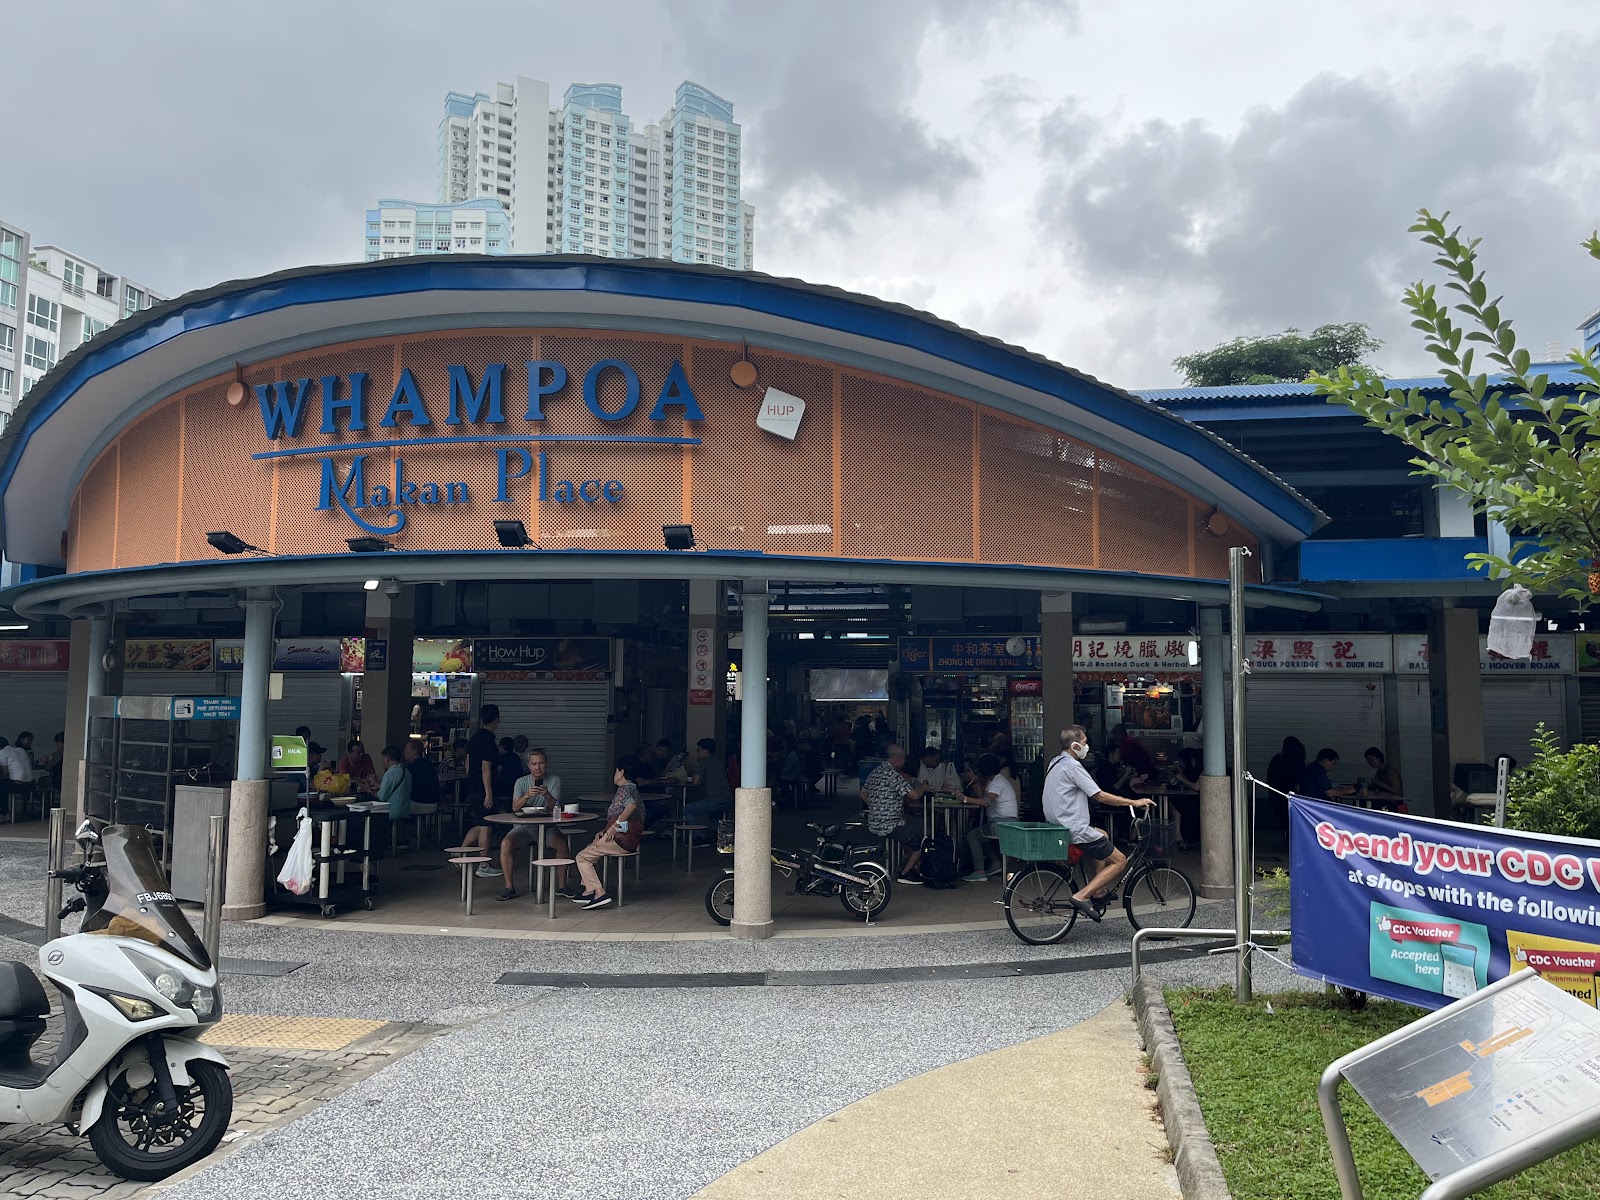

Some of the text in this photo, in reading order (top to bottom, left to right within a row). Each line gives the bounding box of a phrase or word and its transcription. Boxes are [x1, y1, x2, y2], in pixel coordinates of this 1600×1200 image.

[253, 358, 704, 440] WHAMPOA
[767, 405, 795, 416] HUP
[314, 447, 623, 534] Makan Place
[287, 645, 331, 655] Swee Lee
[489, 645, 518, 658] How
[520, 644, 545, 660] Hup
[902, 648, 928, 662] Tiger
[952, 642, 1006, 656] 中和茶室
[1251, 640, 1357, 660] 梁照記
[315, 656, 336, 666] Food
[938, 658, 1020, 667] ZHONG HE DRINK STALL
[1256, 661, 1277, 669] DUCK
[1280, 661, 1319, 669] PORRIDGE
[1346, 661, 1385, 669] DUCK RICE
[1489, 662, 1526, 670] HOOVER
[1530, 662, 1561, 670] ROJAK
[1316, 822, 1412, 860] Spend
[1414, 843, 1495, 876] your
[1496, 847, 1585, 890] CDC
[1348, 869, 1364, 885] at
[1366, 870, 1425, 899] shops
[1427, 884, 1473, 907] with
[1476, 890, 1513, 913] the
[1392, 924, 1454, 938] CDC Voucher
[1390, 948, 1440, 963] Accepted
[1529, 954, 1596, 968] CDC Voucher
[1414, 963, 1440, 976] here
[1546, 973, 1590, 983] Supermarket
